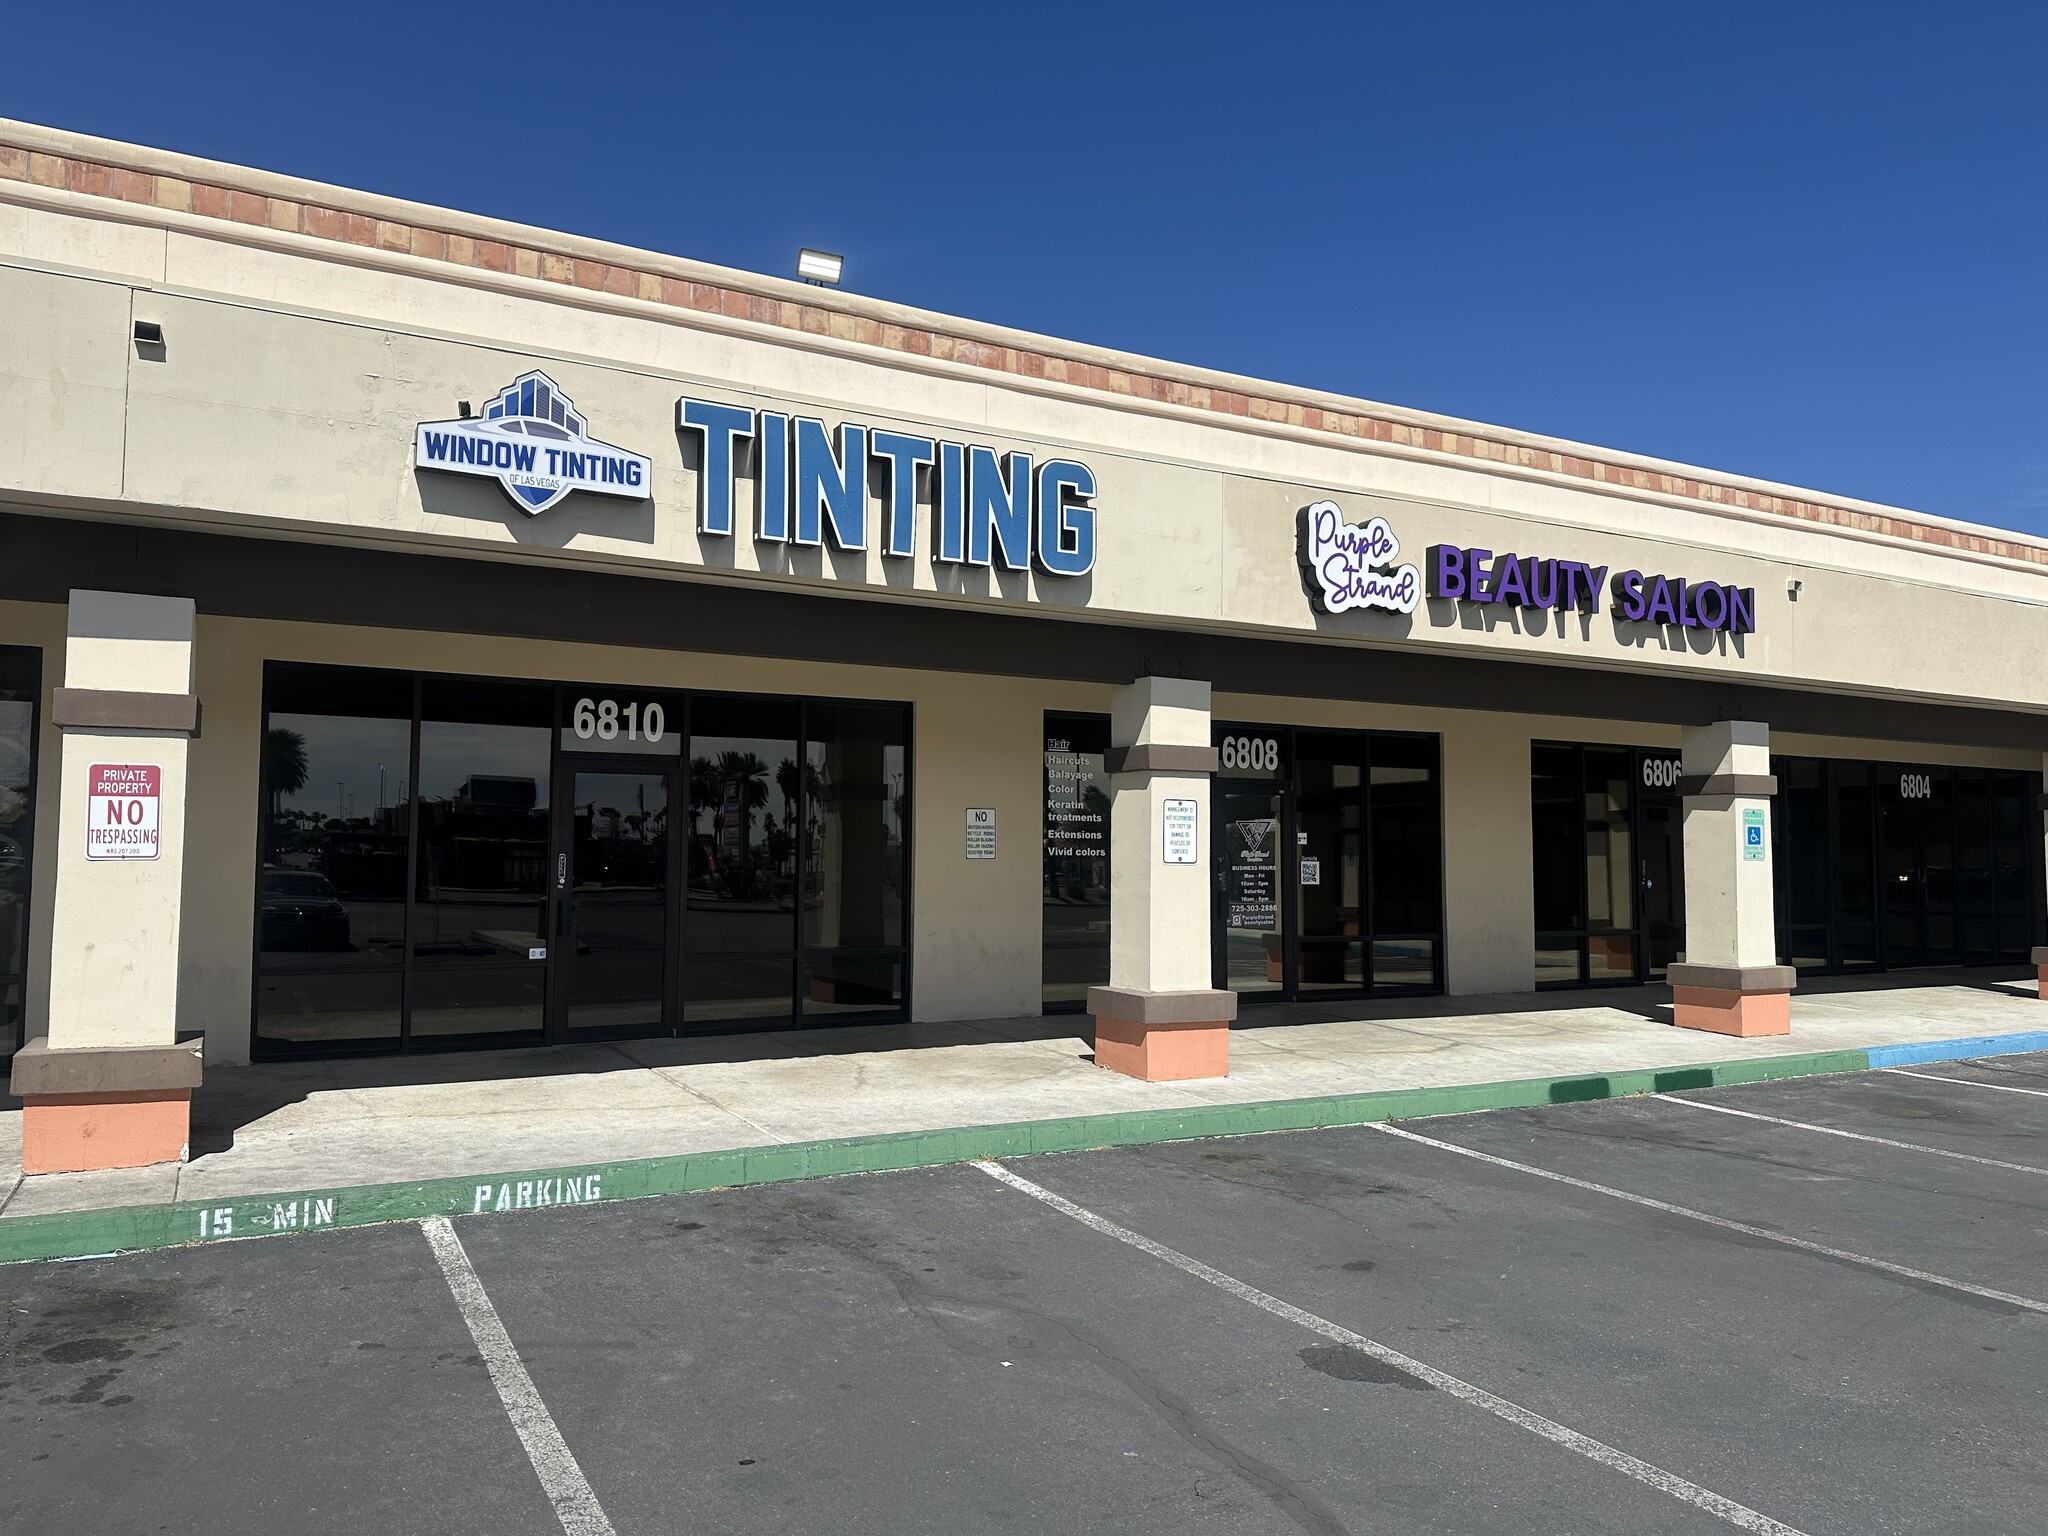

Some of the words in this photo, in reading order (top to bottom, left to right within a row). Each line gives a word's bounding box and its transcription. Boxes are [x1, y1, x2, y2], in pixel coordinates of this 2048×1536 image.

[424, 431, 537, 472] WINDOW
[545, 448, 642, 487] TINTING
[509, 473, 519, 484] OF
[520, 475, 535, 486] LAS
[535, 477, 560, 489] VEGAS
[679, 397, 1098, 577] TINTING
[1315, 509, 1393, 569] Purple
[1323, 552, 1415, 605] Strand
[1438, 543, 1609, 614] BEAUTY
[1622, 569, 1756, 634] SALON
[573, 698, 665, 743] 6810
[1047, 738, 1071, 751] Hair
[1048, 755, 1090, 765] Haircuts
[1222, 736, 1279, 771] 6808
[103, 769, 148, 781] PRIVATE
[1048, 769, 1094, 781] Balayage
[97, 781, 153, 794] PROPERTY
[1047, 784, 1075, 794] Color
[1900, 773, 1931, 799] 6804
[107, 799, 144, 826] NO
[1047, 799, 1084, 810] Keratin
[975, 811, 988, 823] NO
[1047, 812, 1102, 822] treatments
[90, 828, 157, 844] TRESPASSING
[1047, 829, 1102, 839] Extensions
[1047, 846, 1073, 857] Vivid
[1075, 847, 1106, 857] colors
[199, 1207, 233, 1237] 15
[273, 1198, 333, 1230] MIN
[473, 1174, 601, 1214] PARKING
